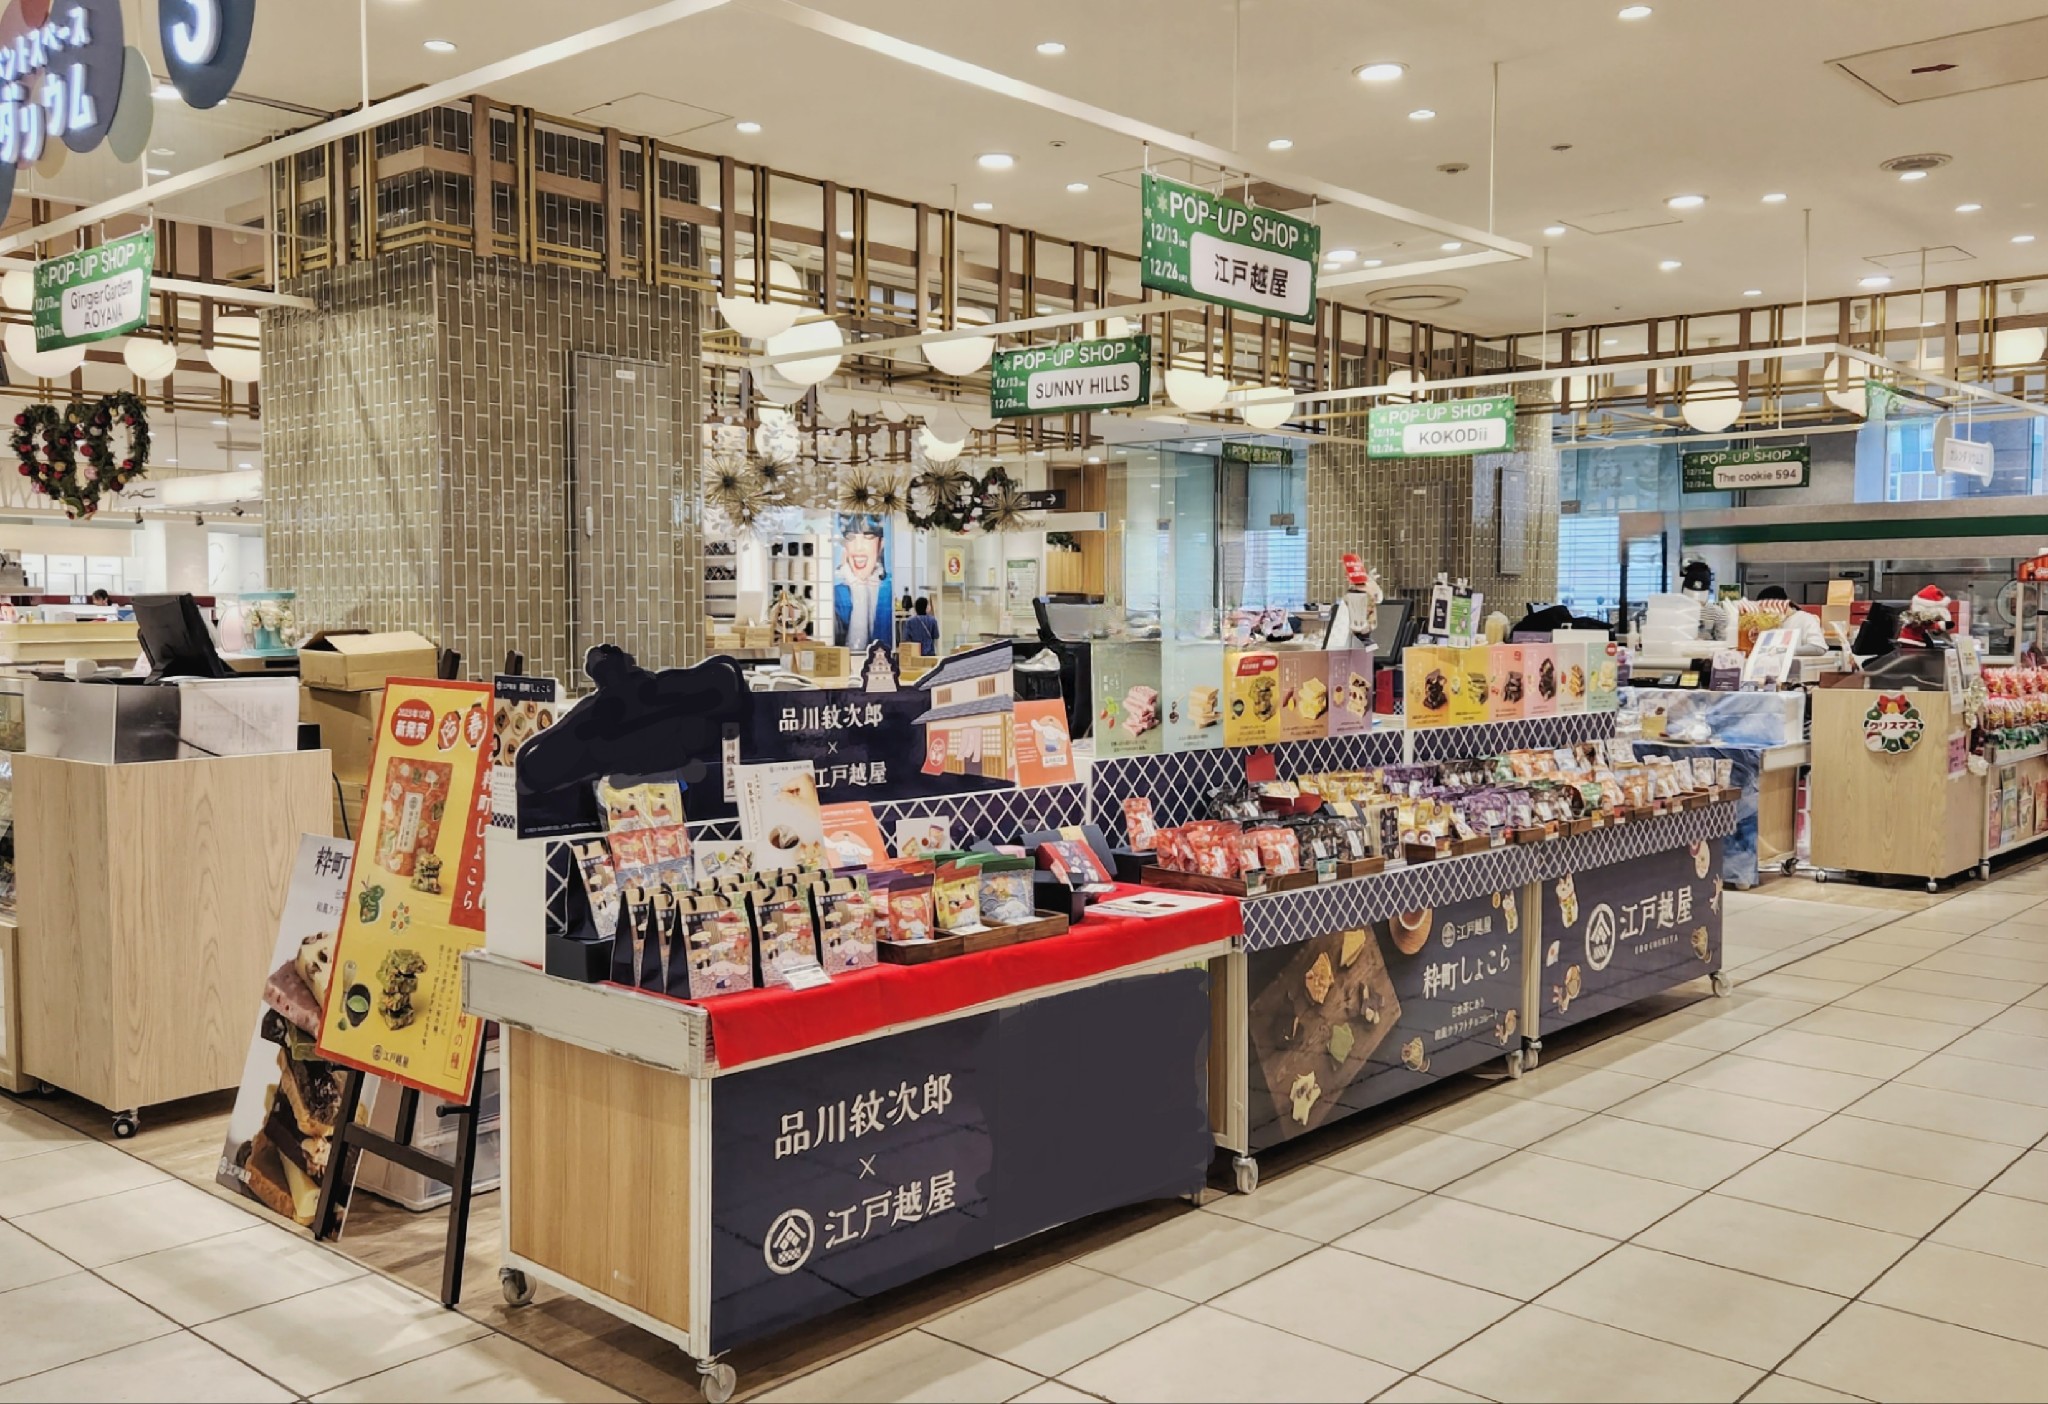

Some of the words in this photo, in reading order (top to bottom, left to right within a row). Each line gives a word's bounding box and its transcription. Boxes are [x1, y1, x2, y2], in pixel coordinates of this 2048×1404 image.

[0, 7, 91, 80] ントスペース
[1169, 191, 1248, 236] POP-UP
[1251, 215, 1299, 250] SHOP
[48, 254, 98, 288] POP-UP
[101, 243, 135, 273] SHOP
[1214, 254, 1289, 298] 江戸越屋
[1012, 349, 1074, 371] POP-UP
[1079, 342, 1126, 364] SHOP
[1036, 379, 1084, 399] SUNNY
[1090, 375, 1129, 395] HILLS
[1388, 407, 1448, 424] POP-UP
[1451, 402, 1494, 419] SHOP
[1754, 450, 1792, 462] SHOP
[1718, 473, 1736, 482] The
[1738, 470, 1773, 482] cookie
[1775, 469, 1797, 479] 594
[779, 702, 884, 732] 品川紋次郎
[1869, 721, 1918, 730] クリスマス
[1456, 915, 1492, 941] 江戸越屋
[1619, 885, 1693, 940] 江戸越屋
[1422, 944, 1511, 999] 粋町しょこら
[775, 1073, 953, 1160] 品川紋次郎
[824, 1169, 957, 1249] 江戸越屋
